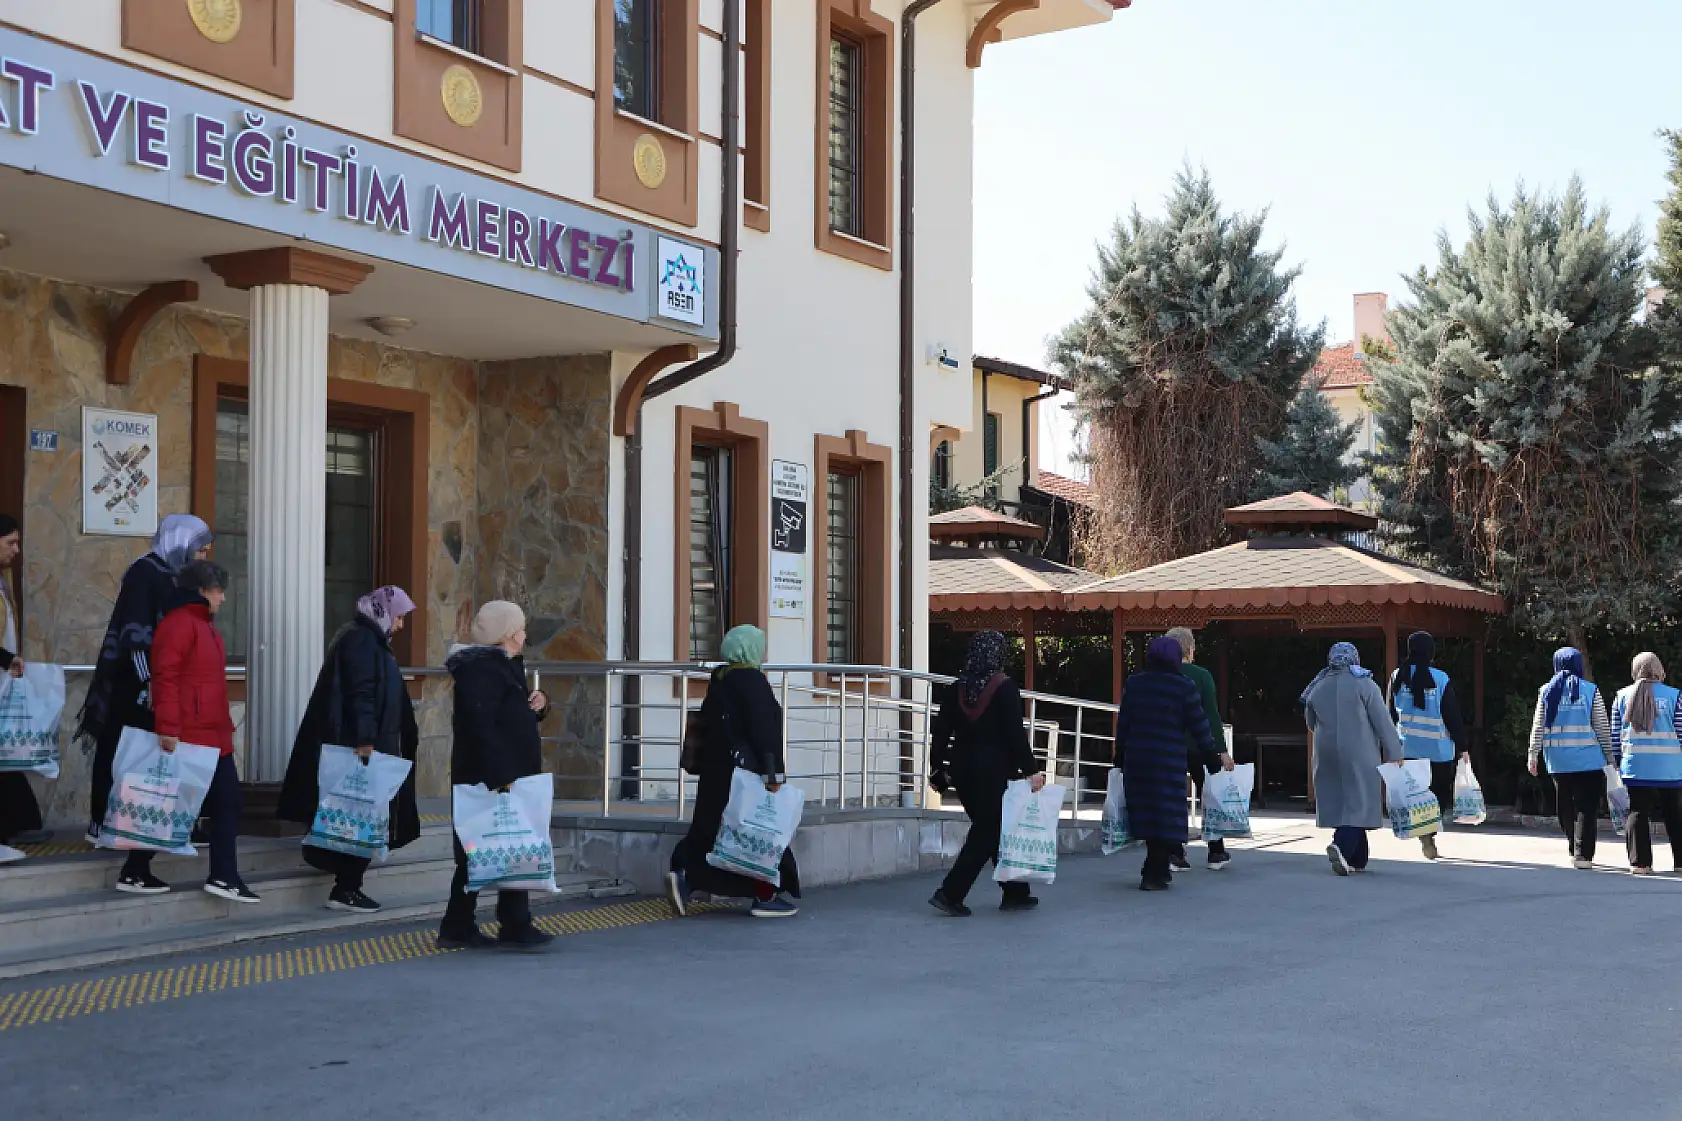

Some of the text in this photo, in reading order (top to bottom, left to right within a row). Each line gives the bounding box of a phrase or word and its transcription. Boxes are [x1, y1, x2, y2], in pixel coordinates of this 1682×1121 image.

[0, 55, 635, 293] T VE EĞİTİM MERKEZİ
[107, 419, 150, 436] KOMEK
